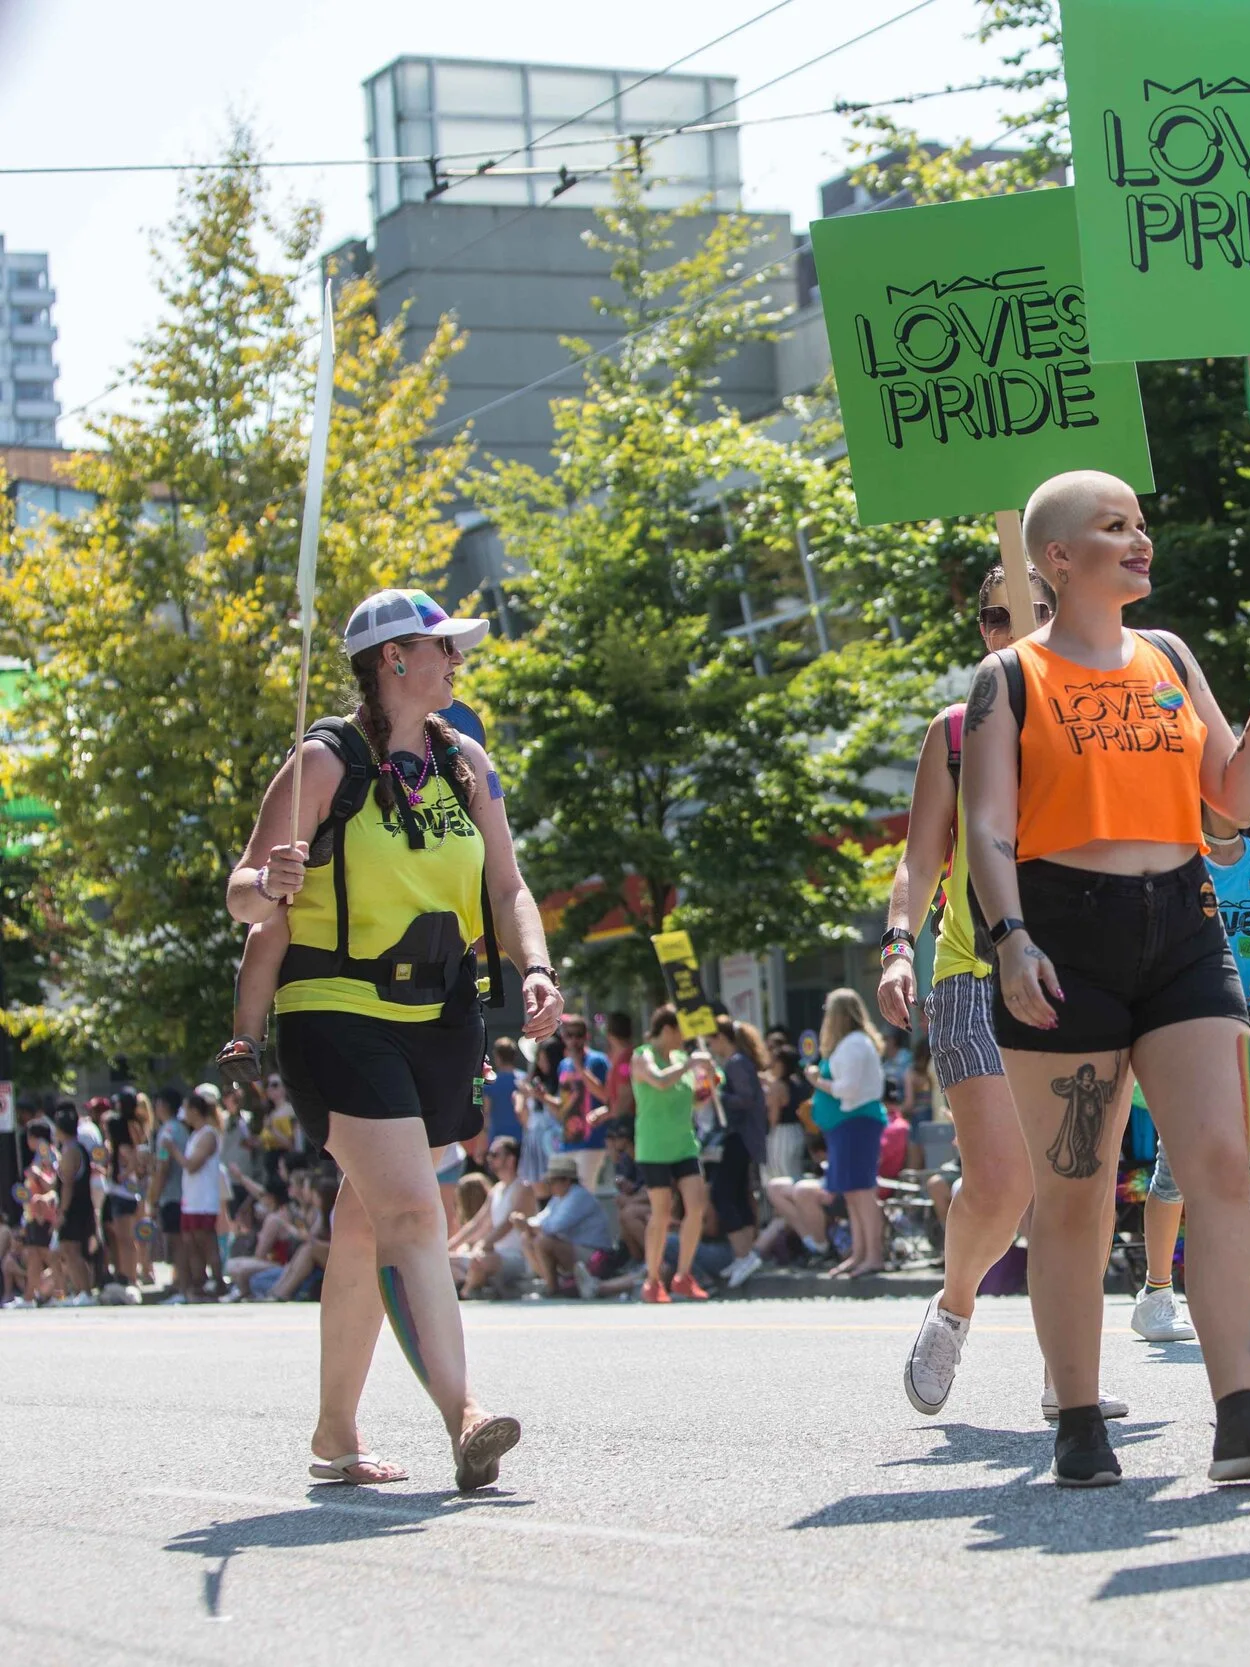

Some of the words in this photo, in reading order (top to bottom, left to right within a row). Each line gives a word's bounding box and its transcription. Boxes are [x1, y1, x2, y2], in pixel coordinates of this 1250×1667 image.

[855, 285, 1088, 377] LOVES
[880, 360, 1099, 447] PRIDE
[1048, 690, 1178, 724] LOVE
[1065, 719, 1184, 755] PRIDE
